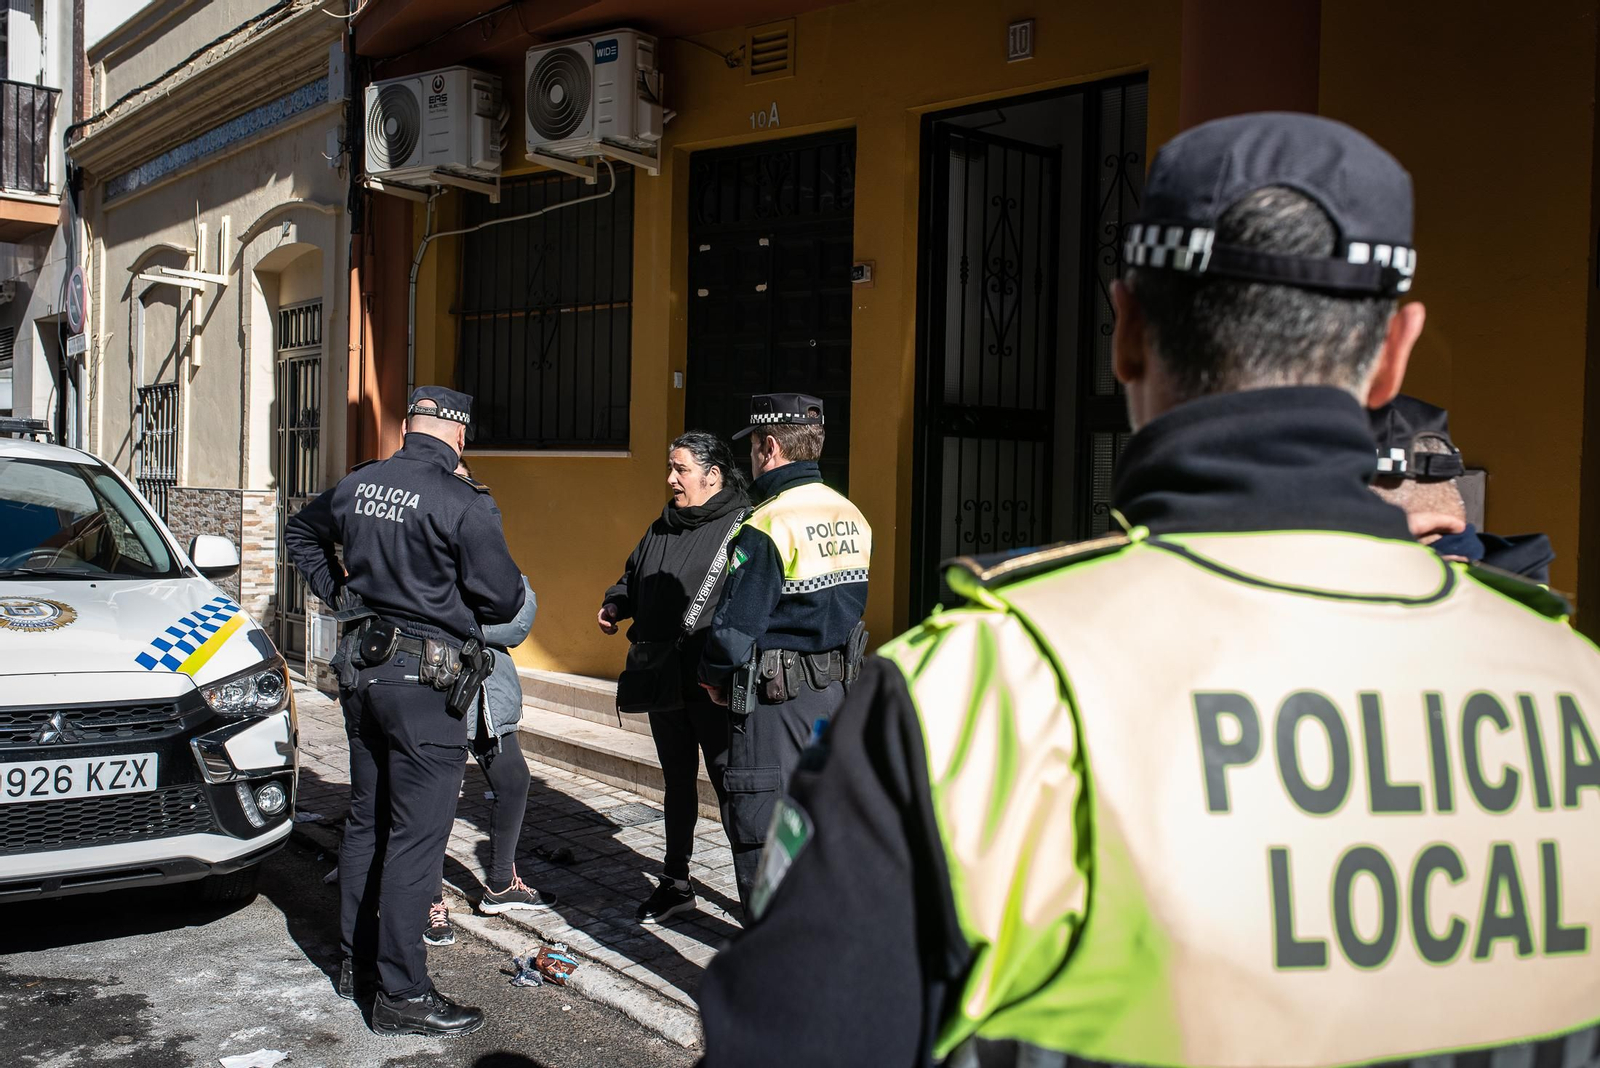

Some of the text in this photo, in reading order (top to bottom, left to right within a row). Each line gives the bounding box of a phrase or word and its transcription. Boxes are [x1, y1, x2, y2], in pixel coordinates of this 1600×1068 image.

[596, 45, 617, 58] WIDE
[1011, 25, 1028, 55] 10
[750, 101, 780, 129] 10A
[354, 483, 421, 510] POLICIA
[354, 499, 405, 524] LOCAL
[711, 547, 728, 574] BIMBA
[817, 539, 860, 558] LOCAL
[697, 574, 716, 602] BIMBA
[1192, 690, 1600, 815] POLICIA
[0, 758, 149, 798] 926 KZX
[1268, 840, 1589, 970] LOCAL
